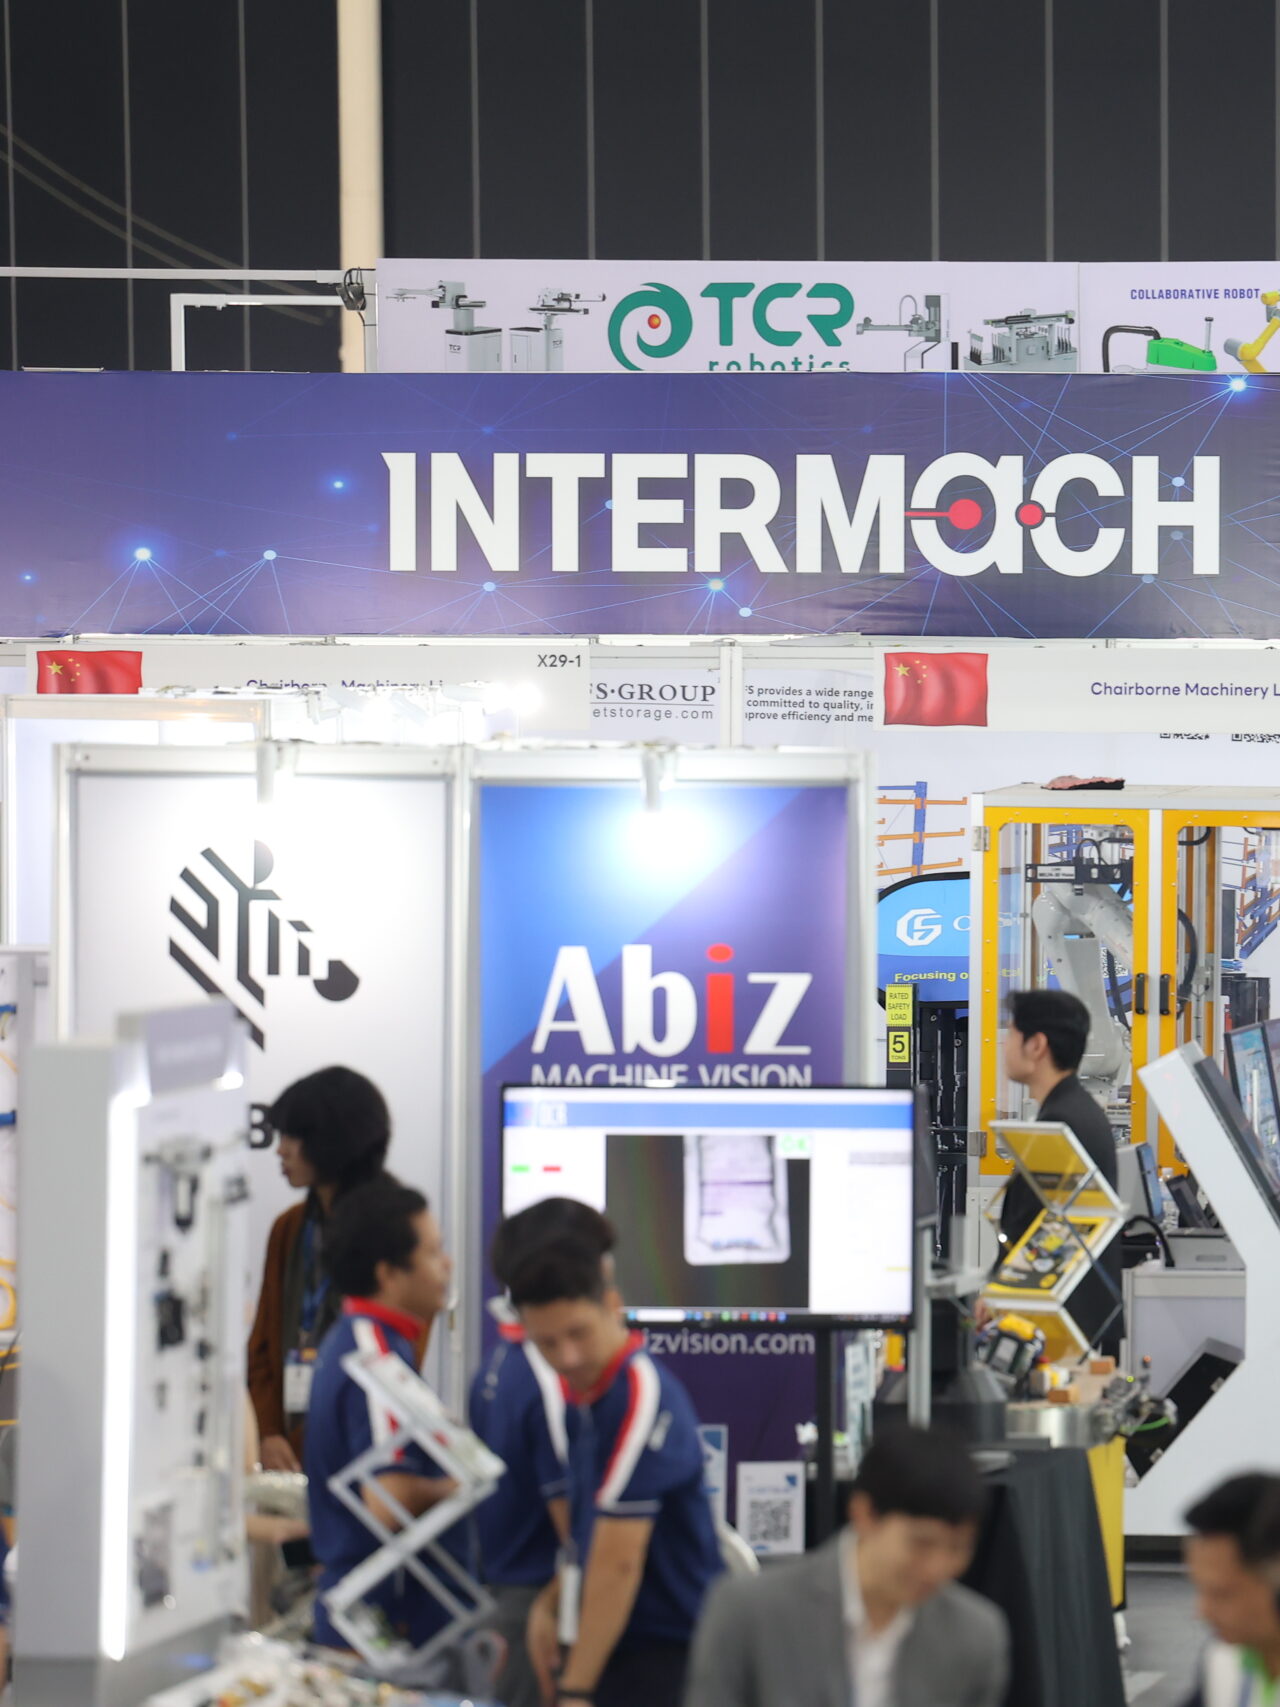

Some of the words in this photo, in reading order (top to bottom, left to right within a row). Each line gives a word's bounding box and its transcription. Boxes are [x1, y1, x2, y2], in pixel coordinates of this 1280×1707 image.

[1130, 288, 1220, 300] COLLABORATIVE
[1223, 288, 1260, 299] ROBOT
[700, 282, 855, 347] TCR
[537, 653, 582, 668] X29-1
[745, 685, 754, 695] S
[757, 686, 803, 697] provides
[805, 688, 812, 696] a
[815, 687, 840, 697] wide
[843, 689, 874, 700] range
[1090, 682, 1181, 696] Chairborne
[1184, 682, 1269, 700] Machinery
[746, 699, 805, 709] committed
[808, 700, 820, 709] to
[823, 700, 863, 712] quality,
[592, 706, 714, 721] etstorage.com
[781, 711, 832, 724] efficiency
[834, 713, 854, 722] and
[894, 970, 956, 983] Focusing
[531, 943, 813, 1058] Abiz
[889, 992, 909, 1000] RATED
[887, 1002, 910, 1010] SAFETY
[890, 1013, 907, 1021] LOAD
[892, 1034, 906, 1053] 5
[531, 1063, 689, 1087] MACHINE
[698, 1063, 812, 1087] VISION
[642, 1327, 816, 1355] izvision.com
